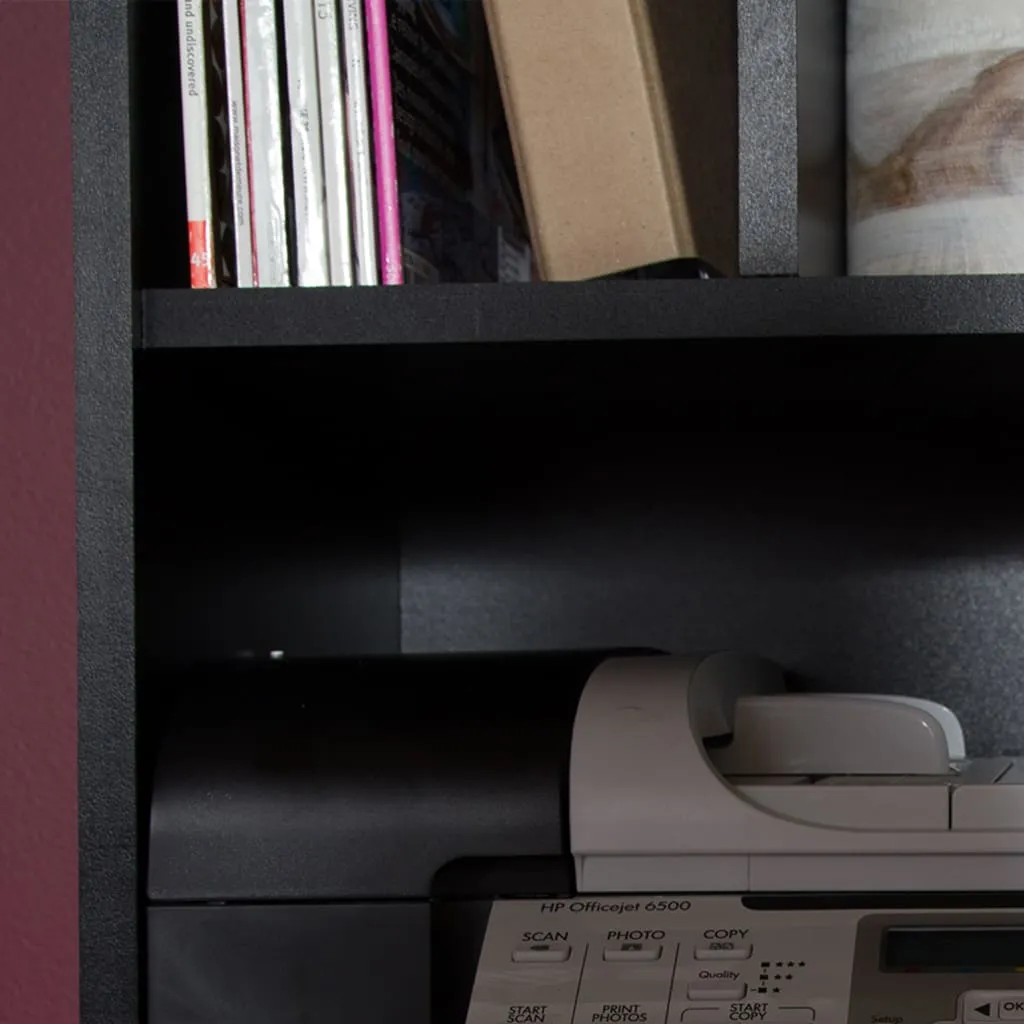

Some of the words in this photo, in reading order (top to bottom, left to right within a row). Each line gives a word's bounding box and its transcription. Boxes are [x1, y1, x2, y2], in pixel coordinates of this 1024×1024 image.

[185, 21, 198, 96] undiscovered
[540, 903, 565, 913] HP
[569, 901, 640, 914] Officejet
[644, 901, 692, 912] 6500
[522, 932, 569, 942] SCAN
[607, 930, 666, 940] PHOTO
[703, 929, 749, 940] COPY
[698, 970, 740, 980] Quality
[509, 1005, 547, 1014] START
[602, 1005, 641, 1014] PRINT
[730, 1003, 769, 1012] START
[1003, 1001, 1024, 1011] OK
[507, 1014, 545, 1023] SCAN
[592, 1013, 647, 1022] PHOTOS
[729, 1012, 767, 1021] COPY
